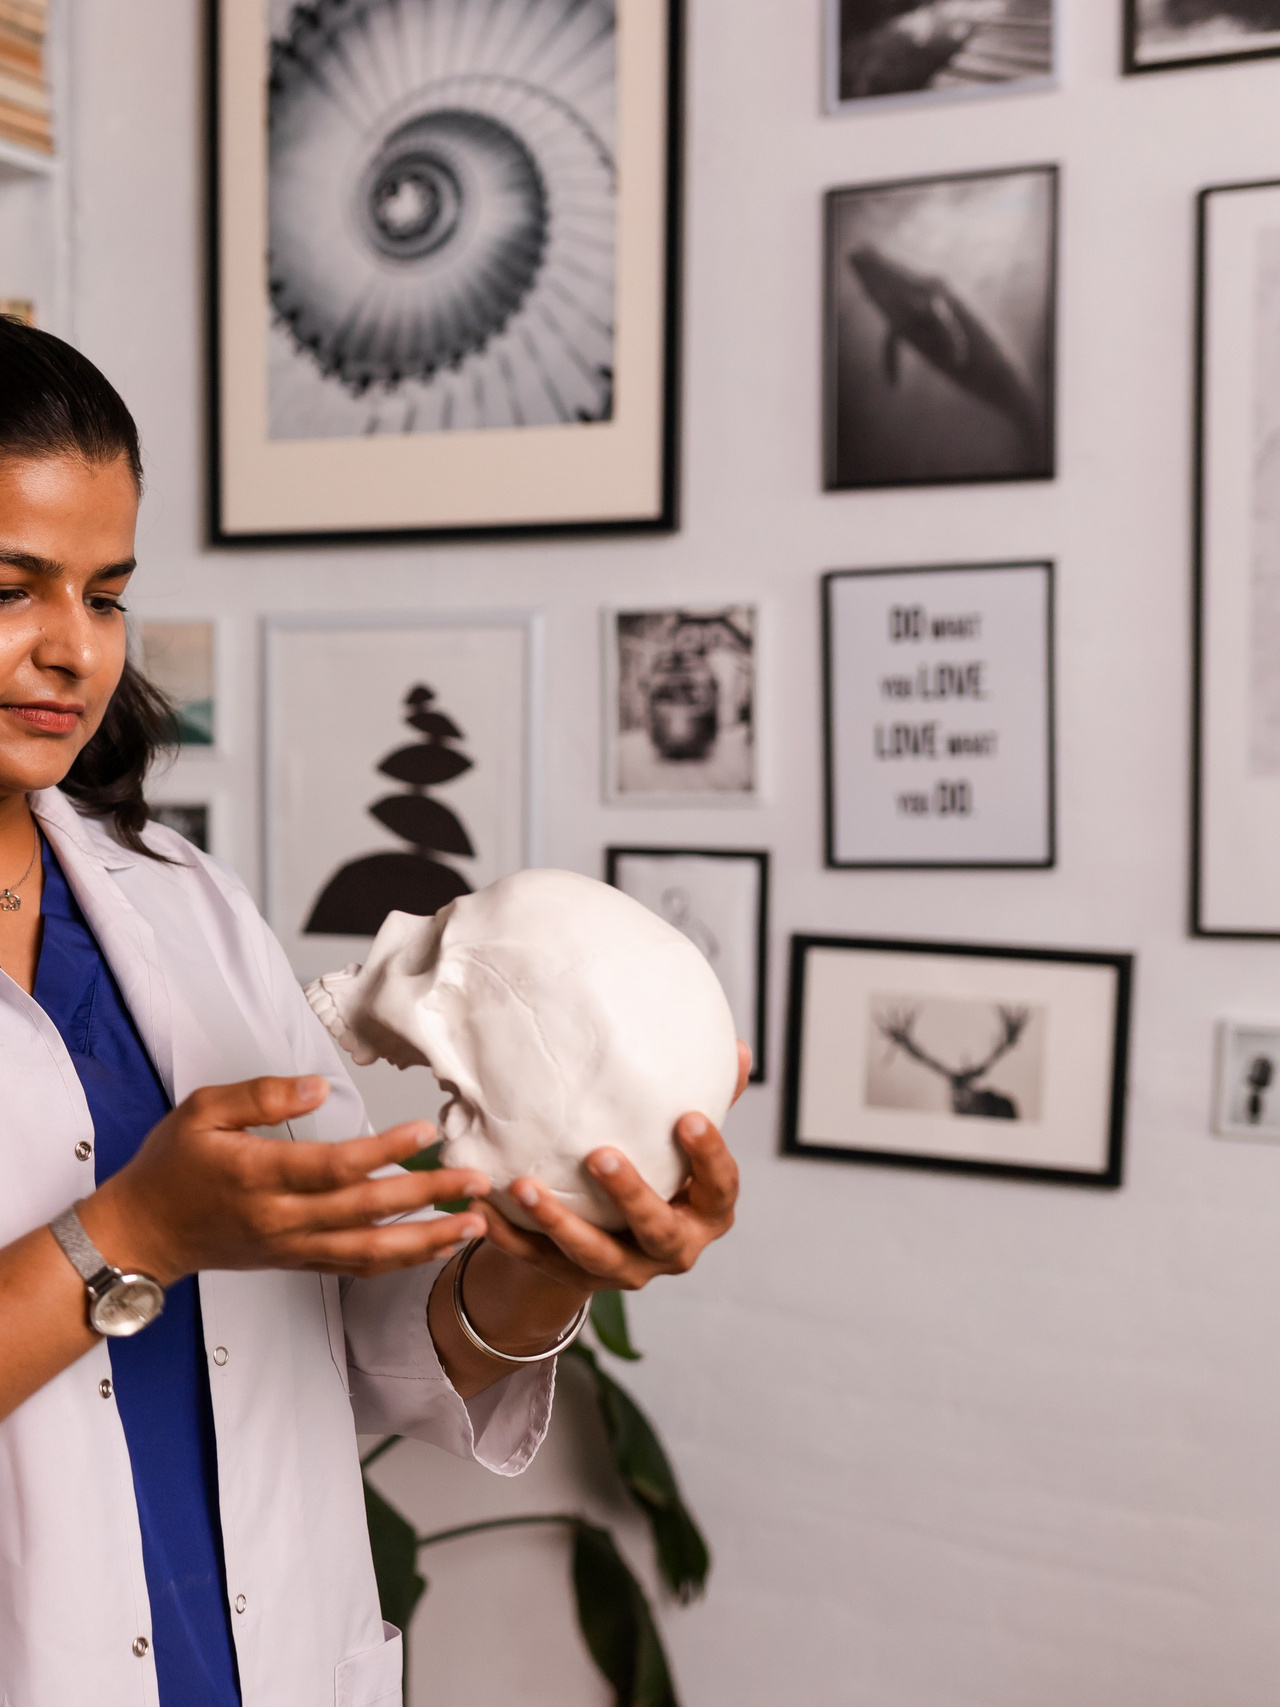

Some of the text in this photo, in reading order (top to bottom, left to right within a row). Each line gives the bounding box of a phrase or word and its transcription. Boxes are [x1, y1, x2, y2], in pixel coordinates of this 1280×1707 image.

[889, 603, 982, 643] DO WHAT
[875, 720, 998, 761] LOVE WHAT
